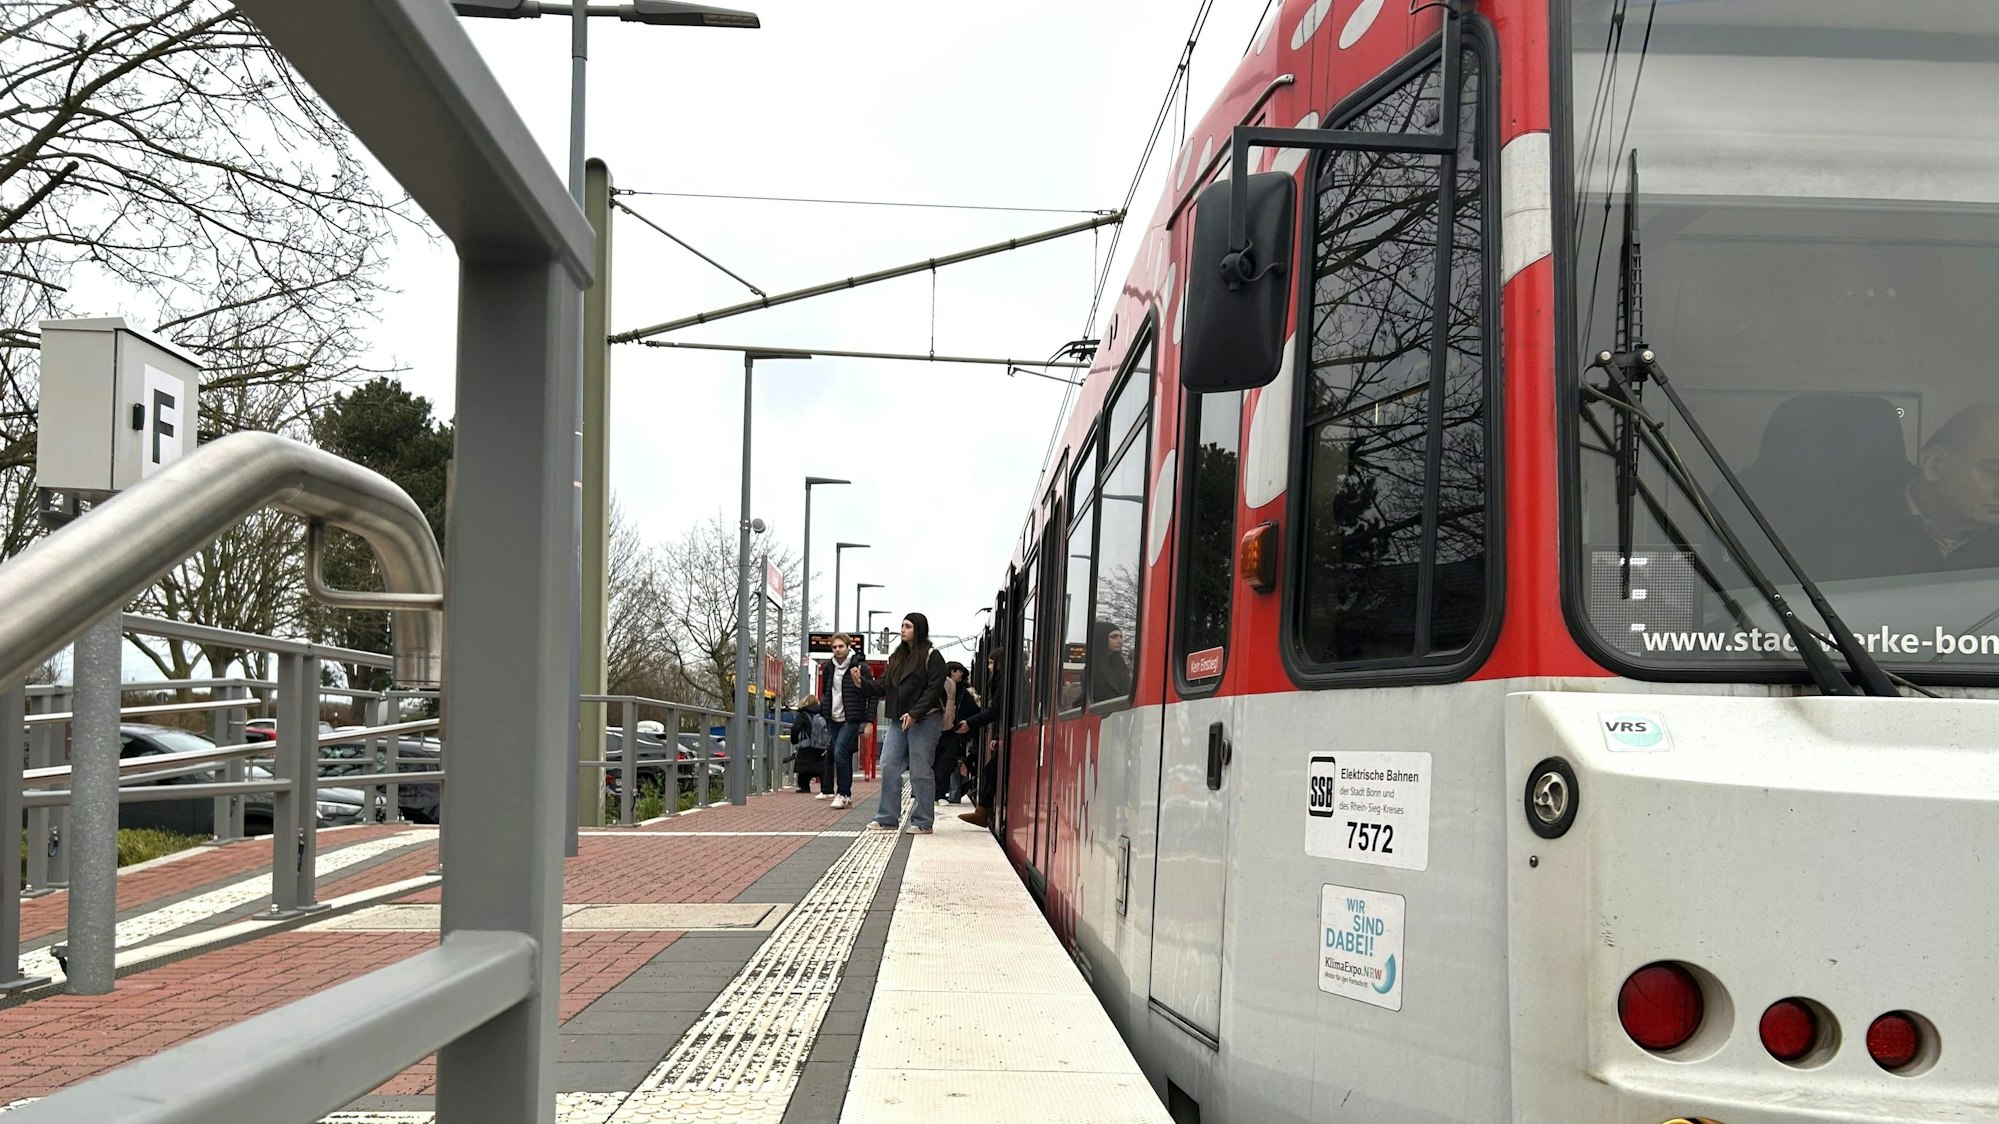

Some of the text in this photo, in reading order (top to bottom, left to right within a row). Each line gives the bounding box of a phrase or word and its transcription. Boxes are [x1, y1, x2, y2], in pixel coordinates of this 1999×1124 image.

[152, 388, 175, 465] F
[1605, 721, 1647, 732] VRS
[1341, 768, 1419, 783] Elektrische Bahnen
[1310, 776, 1333, 808] SSB
[1340, 786, 1395, 799] der Stadt Bonn und
[1339, 800, 1404, 815] des Rhein-Sieg-Kreises
[1347, 821, 1394, 854] 7572
[1346, 897, 1366, 914] WIR
[1353, 914, 1384, 936] SIND
[1326, 927, 1374, 957] DABEI!
[1325, 956, 1382, 980] KlimaExpo.NRW
